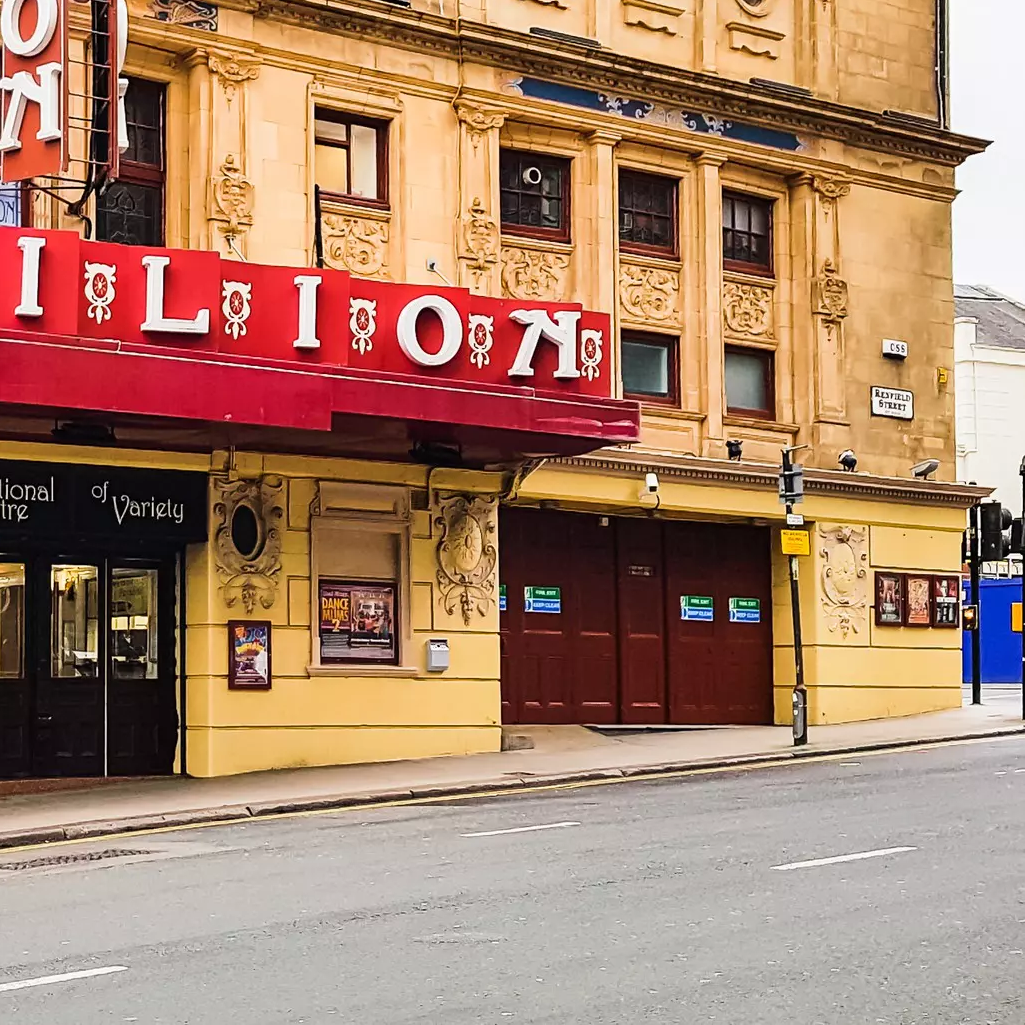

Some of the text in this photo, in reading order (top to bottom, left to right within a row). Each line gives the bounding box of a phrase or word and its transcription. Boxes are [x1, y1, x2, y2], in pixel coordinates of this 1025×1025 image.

[878, 399, 907, 412] STREET
[91, 481, 109, 503] of
[112, 494, 184, 525] Variety
[322, 597, 349, 610] DANCE
[331, 618, 341, 633] 2
